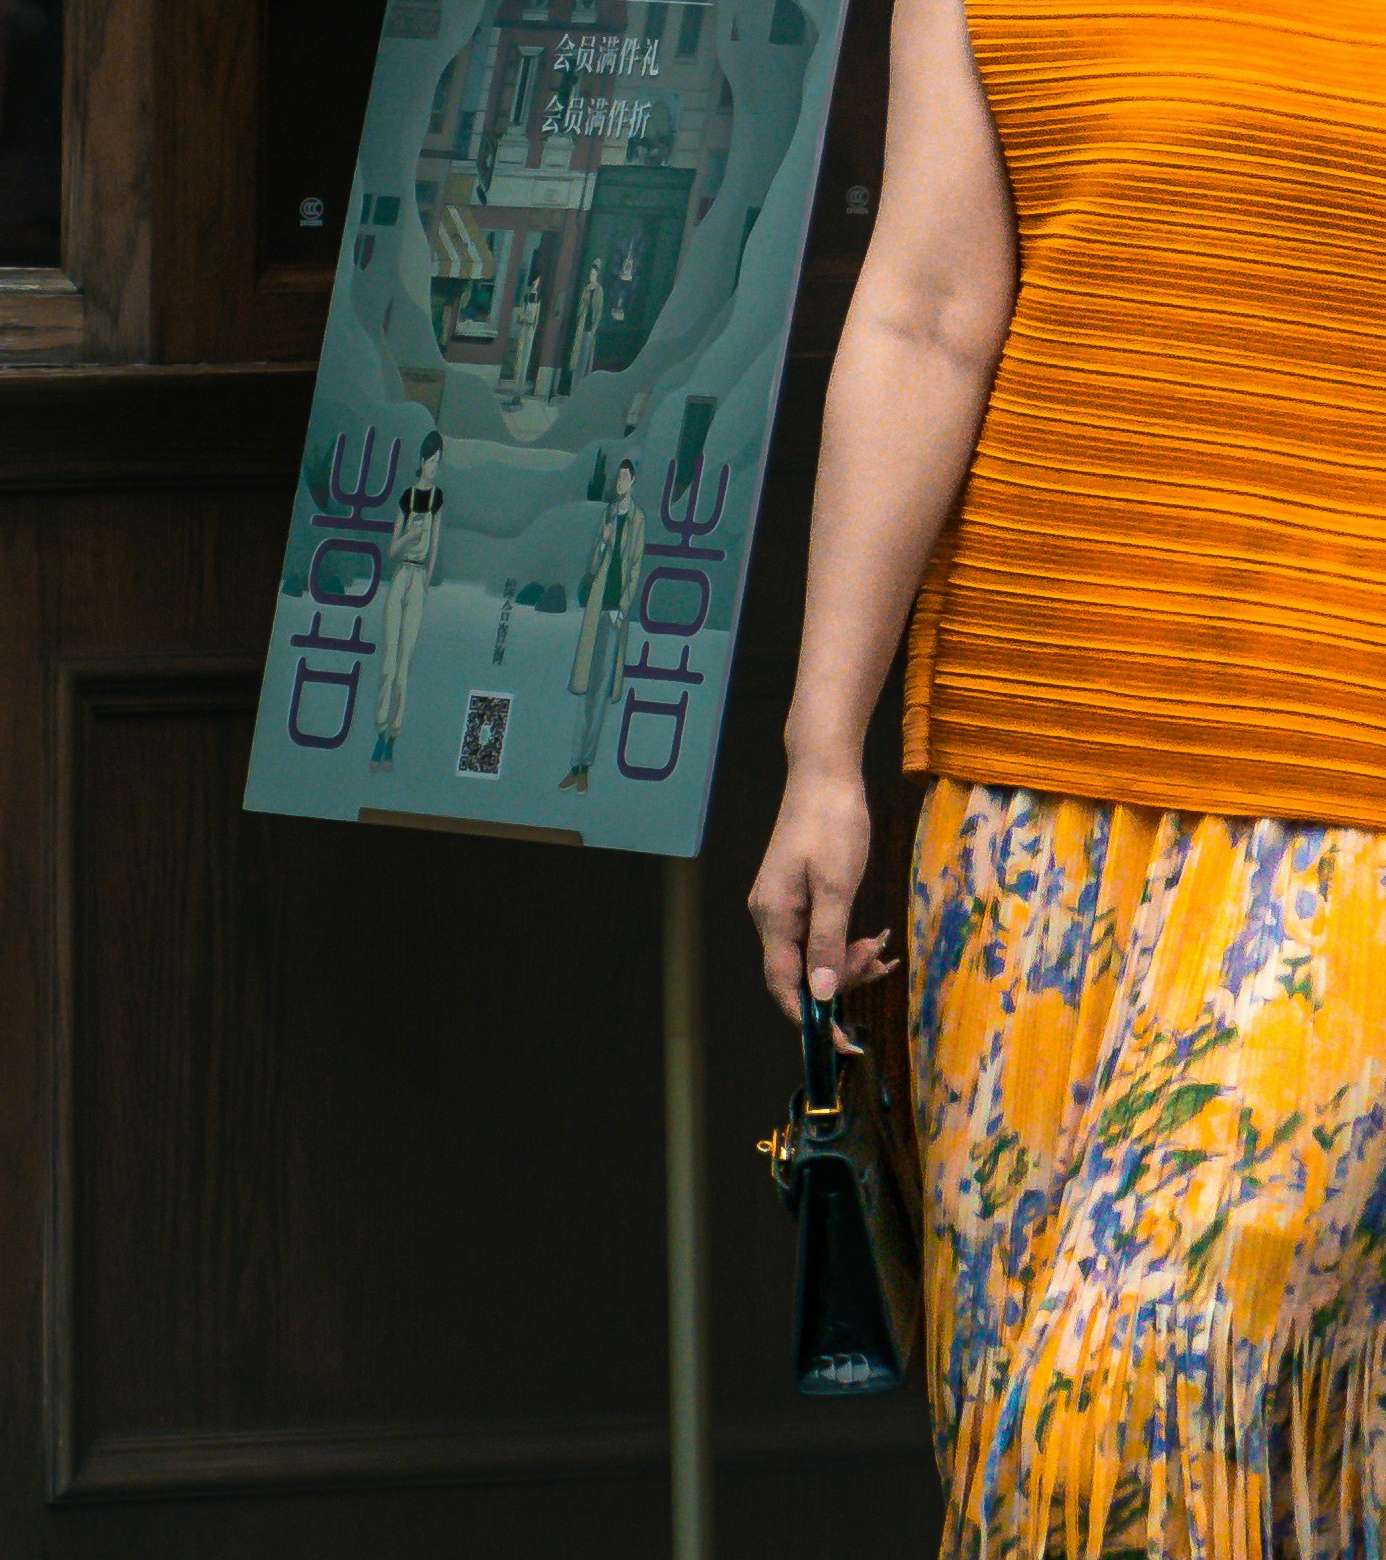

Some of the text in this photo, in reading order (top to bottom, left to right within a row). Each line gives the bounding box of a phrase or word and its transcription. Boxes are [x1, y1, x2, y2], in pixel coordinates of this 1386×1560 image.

[552, 32, 660, 77] 会员满件礼
[541, 93, 653, 140] 会员满件折
